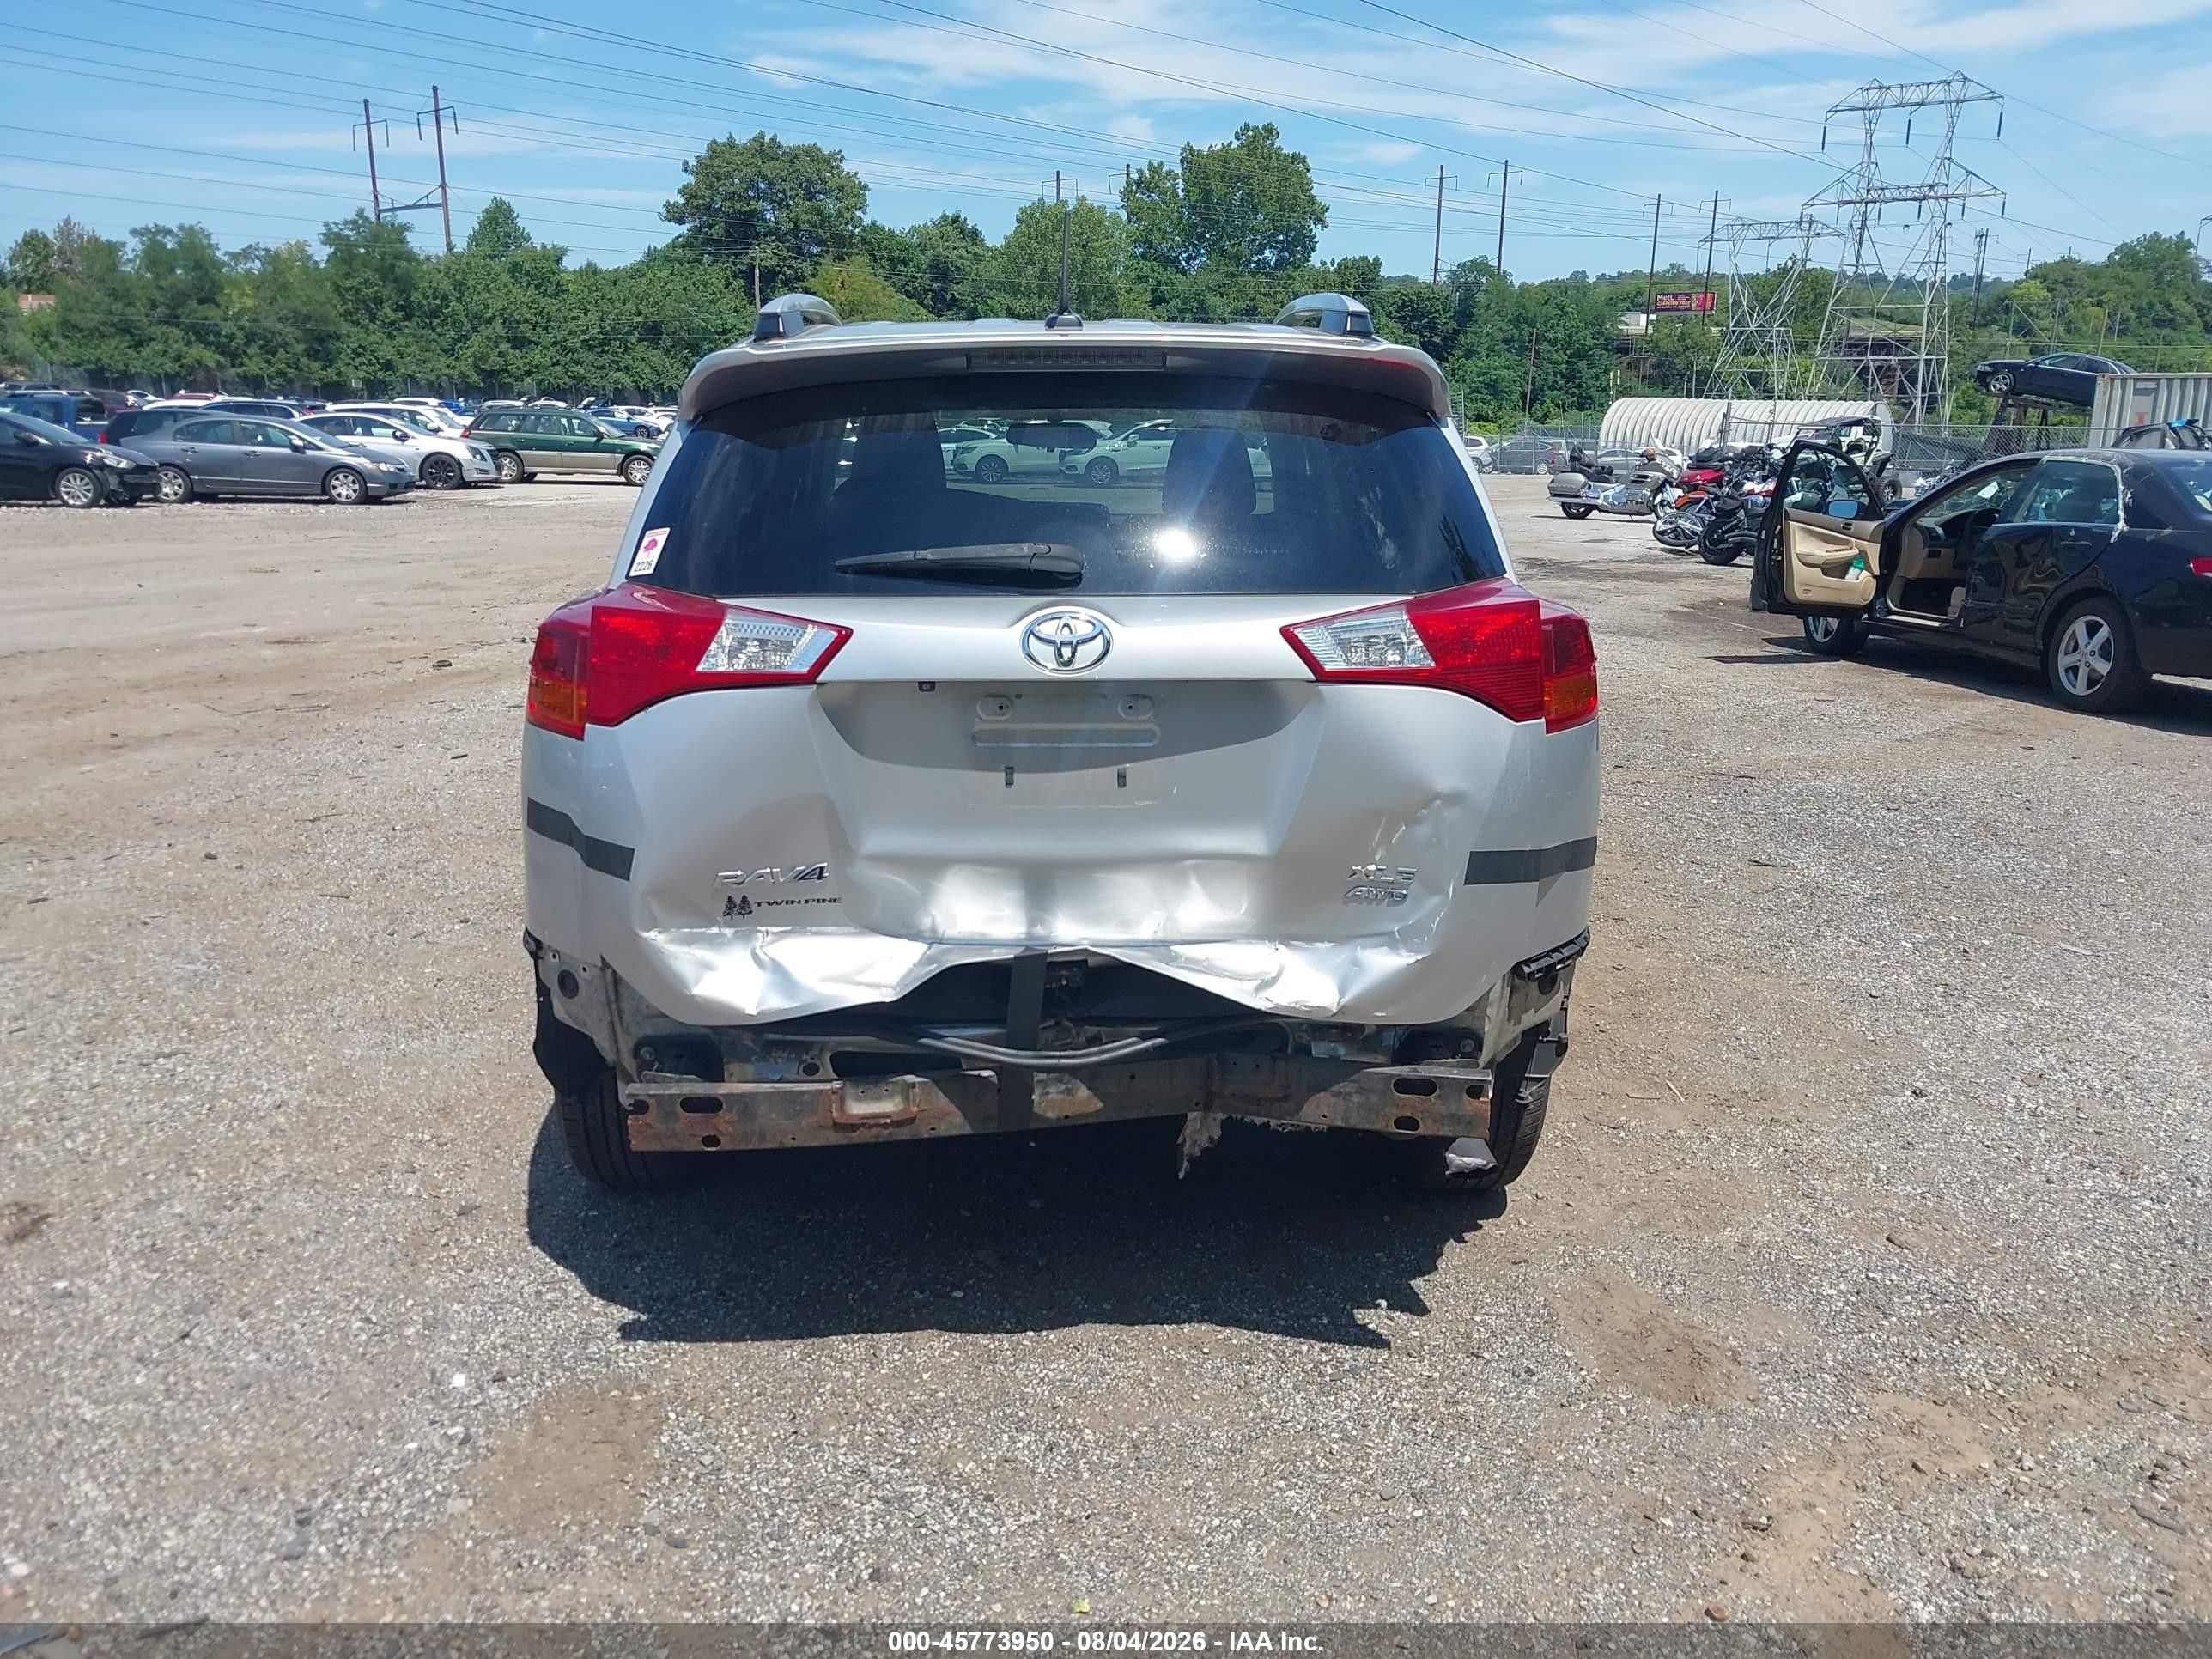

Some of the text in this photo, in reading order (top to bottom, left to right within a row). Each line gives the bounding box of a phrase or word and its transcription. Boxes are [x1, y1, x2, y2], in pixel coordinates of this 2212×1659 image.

[712, 862, 830, 890] RAV4
[1346, 864, 1419, 884] XLE
[755, 896, 843, 908] TWIN PINE
[1341, 885, 1409, 908] AWD
